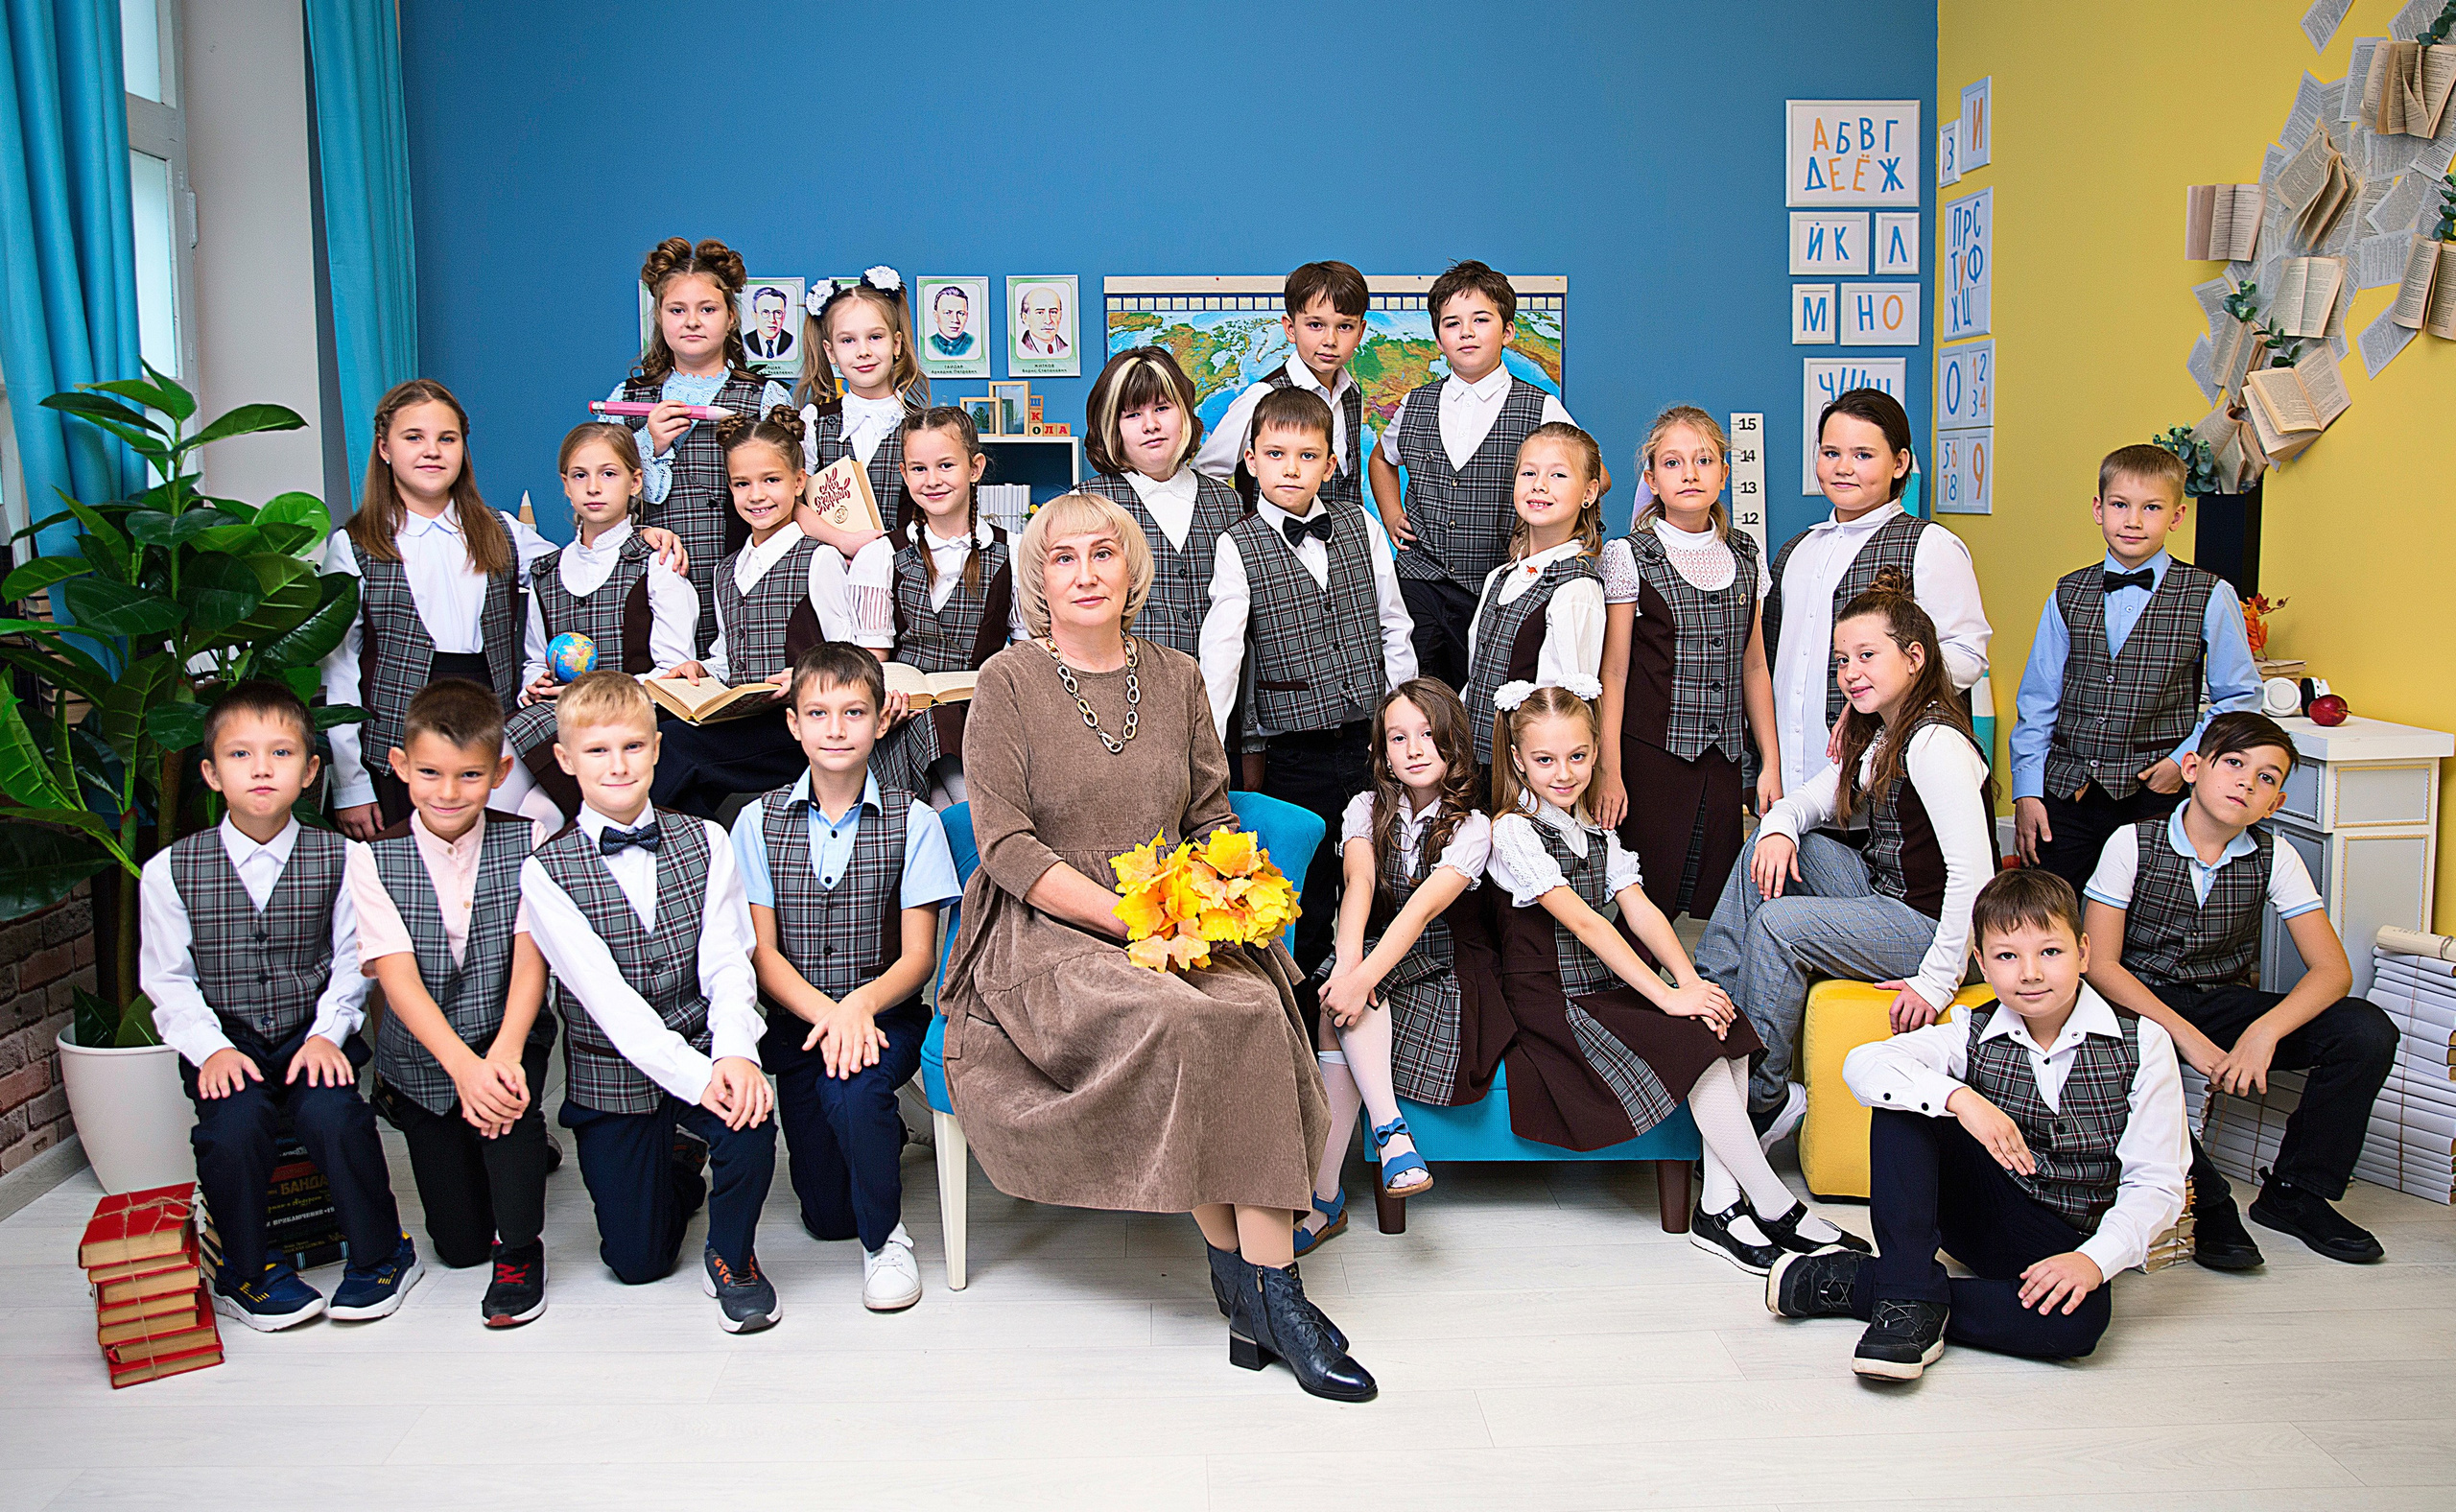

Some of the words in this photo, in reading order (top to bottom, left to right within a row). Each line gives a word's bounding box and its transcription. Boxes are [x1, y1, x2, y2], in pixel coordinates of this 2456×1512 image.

[1812, 117, 1899, 154] АБВГ
[1972, 97, 1983, 152] И
[1804, 154, 1905, 193] ДЕЁЖ
[1888, 225, 1908, 264] Л
[1952, 201, 1981, 250] ПРС
[1950, 244, 1984, 295] ТУФ
[1803, 296, 1827, 332] М
[1856, 294, 1903, 331] НО
[1950, 287, 1972, 333] ХЦ
[1738, 417, 1757, 431] 15
[1739, 449, 1757, 462] 14
[1972, 442, 1985, 500] 9
[1740, 481, 1758, 494] 13
[1741, 511, 1759, 525] 12
